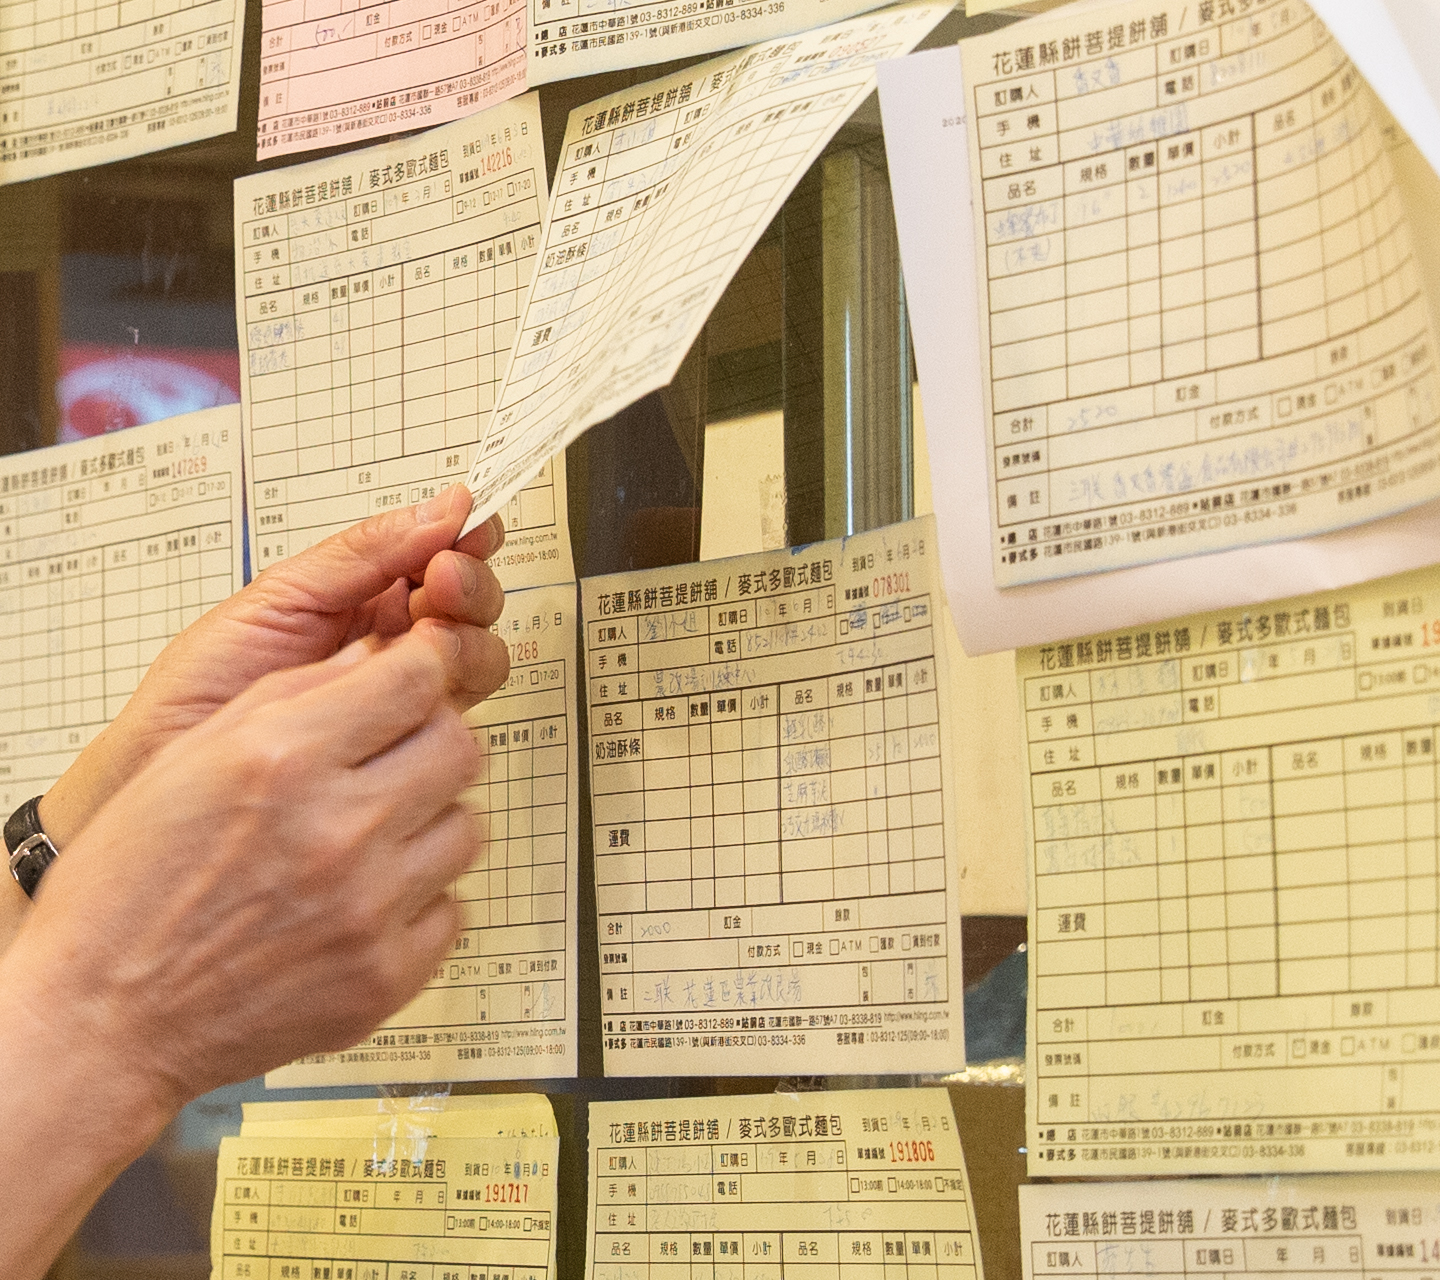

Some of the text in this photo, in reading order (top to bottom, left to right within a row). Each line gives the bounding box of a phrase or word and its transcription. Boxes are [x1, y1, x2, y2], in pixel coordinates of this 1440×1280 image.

[992, 13, 1167, 76] 花蓮縣餅菩提餅舖
[994, 84, 1038, 105] 訂購人
[581, 81, 693, 137] 花蓮縣餅菩提餅舖
[480, 146, 513, 176] 142216
[253, 149, 449, 216] 花蓮縣餅菩提餅舖 麥式多歐式麵包
[252, 226, 279, 240] 訂購人
[172, 456, 207, 478] 147269
[598, 579, 717, 616] 花蓮縣餅菩提餅舖
[738, 559, 833, 595] 麥式多歐式麵包
[873, 573, 910, 598] 078301
[598, 627, 626, 640] 訂購人
[508, 641, 539, 662] 7268
[714, 640, 736, 654] 電話
[1039, 628, 1191, 672] 花蓮縣餅菩提餅舖
[539, 669, 559, 681] 17-20
[595, 738, 641, 759] 奶油酥條
[609, 829, 630, 847] 運費
[1058, 912, 1087, 935] 運費
[748, 944, 781, 958] 付款方式
[529, 959, 557, 972] 貨到付款
[609, 1119, 720, 1144] 花蓮縣餅菩提餅舖
[738, 1115, 842, 1138] 麥式多歐式麵包
[862, 1117, 889, 1132] 到貨日
[890, 1141, 935, 1162] 191806
[238, 1158, 344, 1178] 花蓮縣餅菩提餅舖
[608, 1155, 638, 1171] 訂購人
[720, 1153, 748, 1169] 訂購日
[485, 1184, 528, 1203] 191717
[717, 1181, 738, 1196] 電話
[898, 1180, 933, 1192] 14:00-18:00
[944, 1180, 963, 1192] 不指定
[1045, 1210, 1193, 1237] 花蓮縣餅菩提餅舖
[1221, 1205, 1357, 1235] 麥式多歐式麵包
[611, 1242, 631, 1257] 品名
[660, 1241, 679, 1256] 規格
[692, 1241, 713, 1256] 數量
[720, 1241, 739, 1257] 單價
[751, 1241, 773, 1257] 小計
[798, 1241, 819, 1257] 品名
[851, 1241, 872, 1257] 規格
[884, 1241, 905, 1257] 數量
[911, 1241, 932, 1257] 單價
[943, 1241, 963, 1257] 小計
[1047, 1250, 1081, 1267] 訂購人
